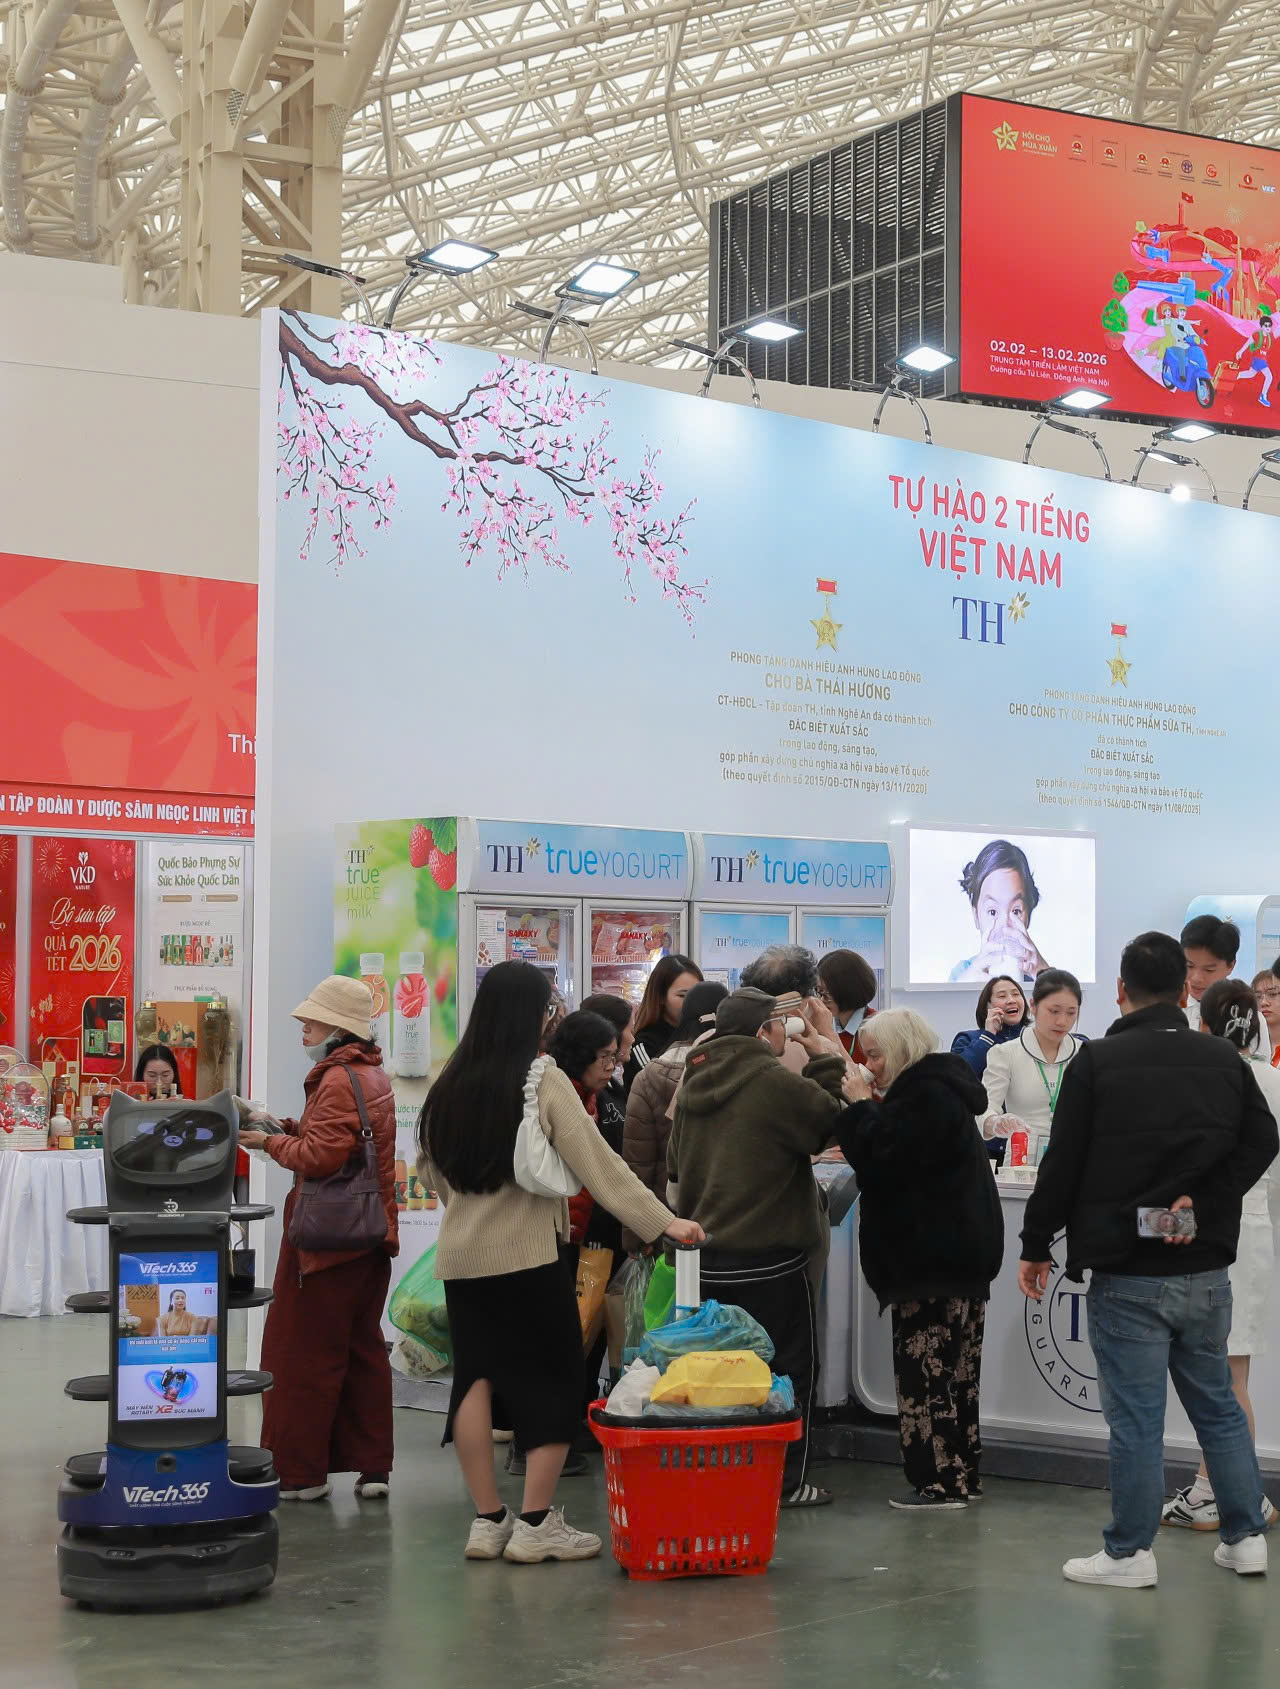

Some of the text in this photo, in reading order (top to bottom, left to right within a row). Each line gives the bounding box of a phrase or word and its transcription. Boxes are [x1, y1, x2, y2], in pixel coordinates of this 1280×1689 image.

[990, 340, 1107, 365] 02.02 13.02.2026
[889, 474, 1090, 543] TỰ HÀO 2 TIẾNG
[920, 523, 1061, 588] VIỆT NAM
[953, 596, 1006, 645] TH
[765, 673, 891, 700] CHO BÀ THÁI HƯƠNG
[809, 721, 827, 734] BIỆT
[829, 721, 850, 735] XUẤT
[853, 724, 868, 737] SẮC
[9, 792, 34, 815] TẬP
[37, 795, 73, 815] ĐOÀN
[76, 799, 85, 815] Y
[88, 799, 121, 820] DƯỢC
[125, 800, 153, 819] SÂM
[157, 804, 189, 825] NGỌC
[193, 806, 220, 823] LINH
[223, 806, 247, 827] VIỆT
[158, 856, 240, 871] Quốc Bảo Phụng Sự
[348, 850, 366, 864] TH
[486, 845, 524, 874] TH
[70, 866, 96, 885] VKD
[347, 866, 380, 884] true
[711, 855, 744, 883] TH
[158, 873, 240, 887] Sức Khỏe Quốc Dân
[346, 886, 380, 901] JUICE
[347, 904, 372, 920] milk
[45, 932, 67, 952] QUÀ
[46, 951, 67, 971] TẾT
[69, 935, 122, 971] 2026
[156, 1405, 173, 1413] X2
